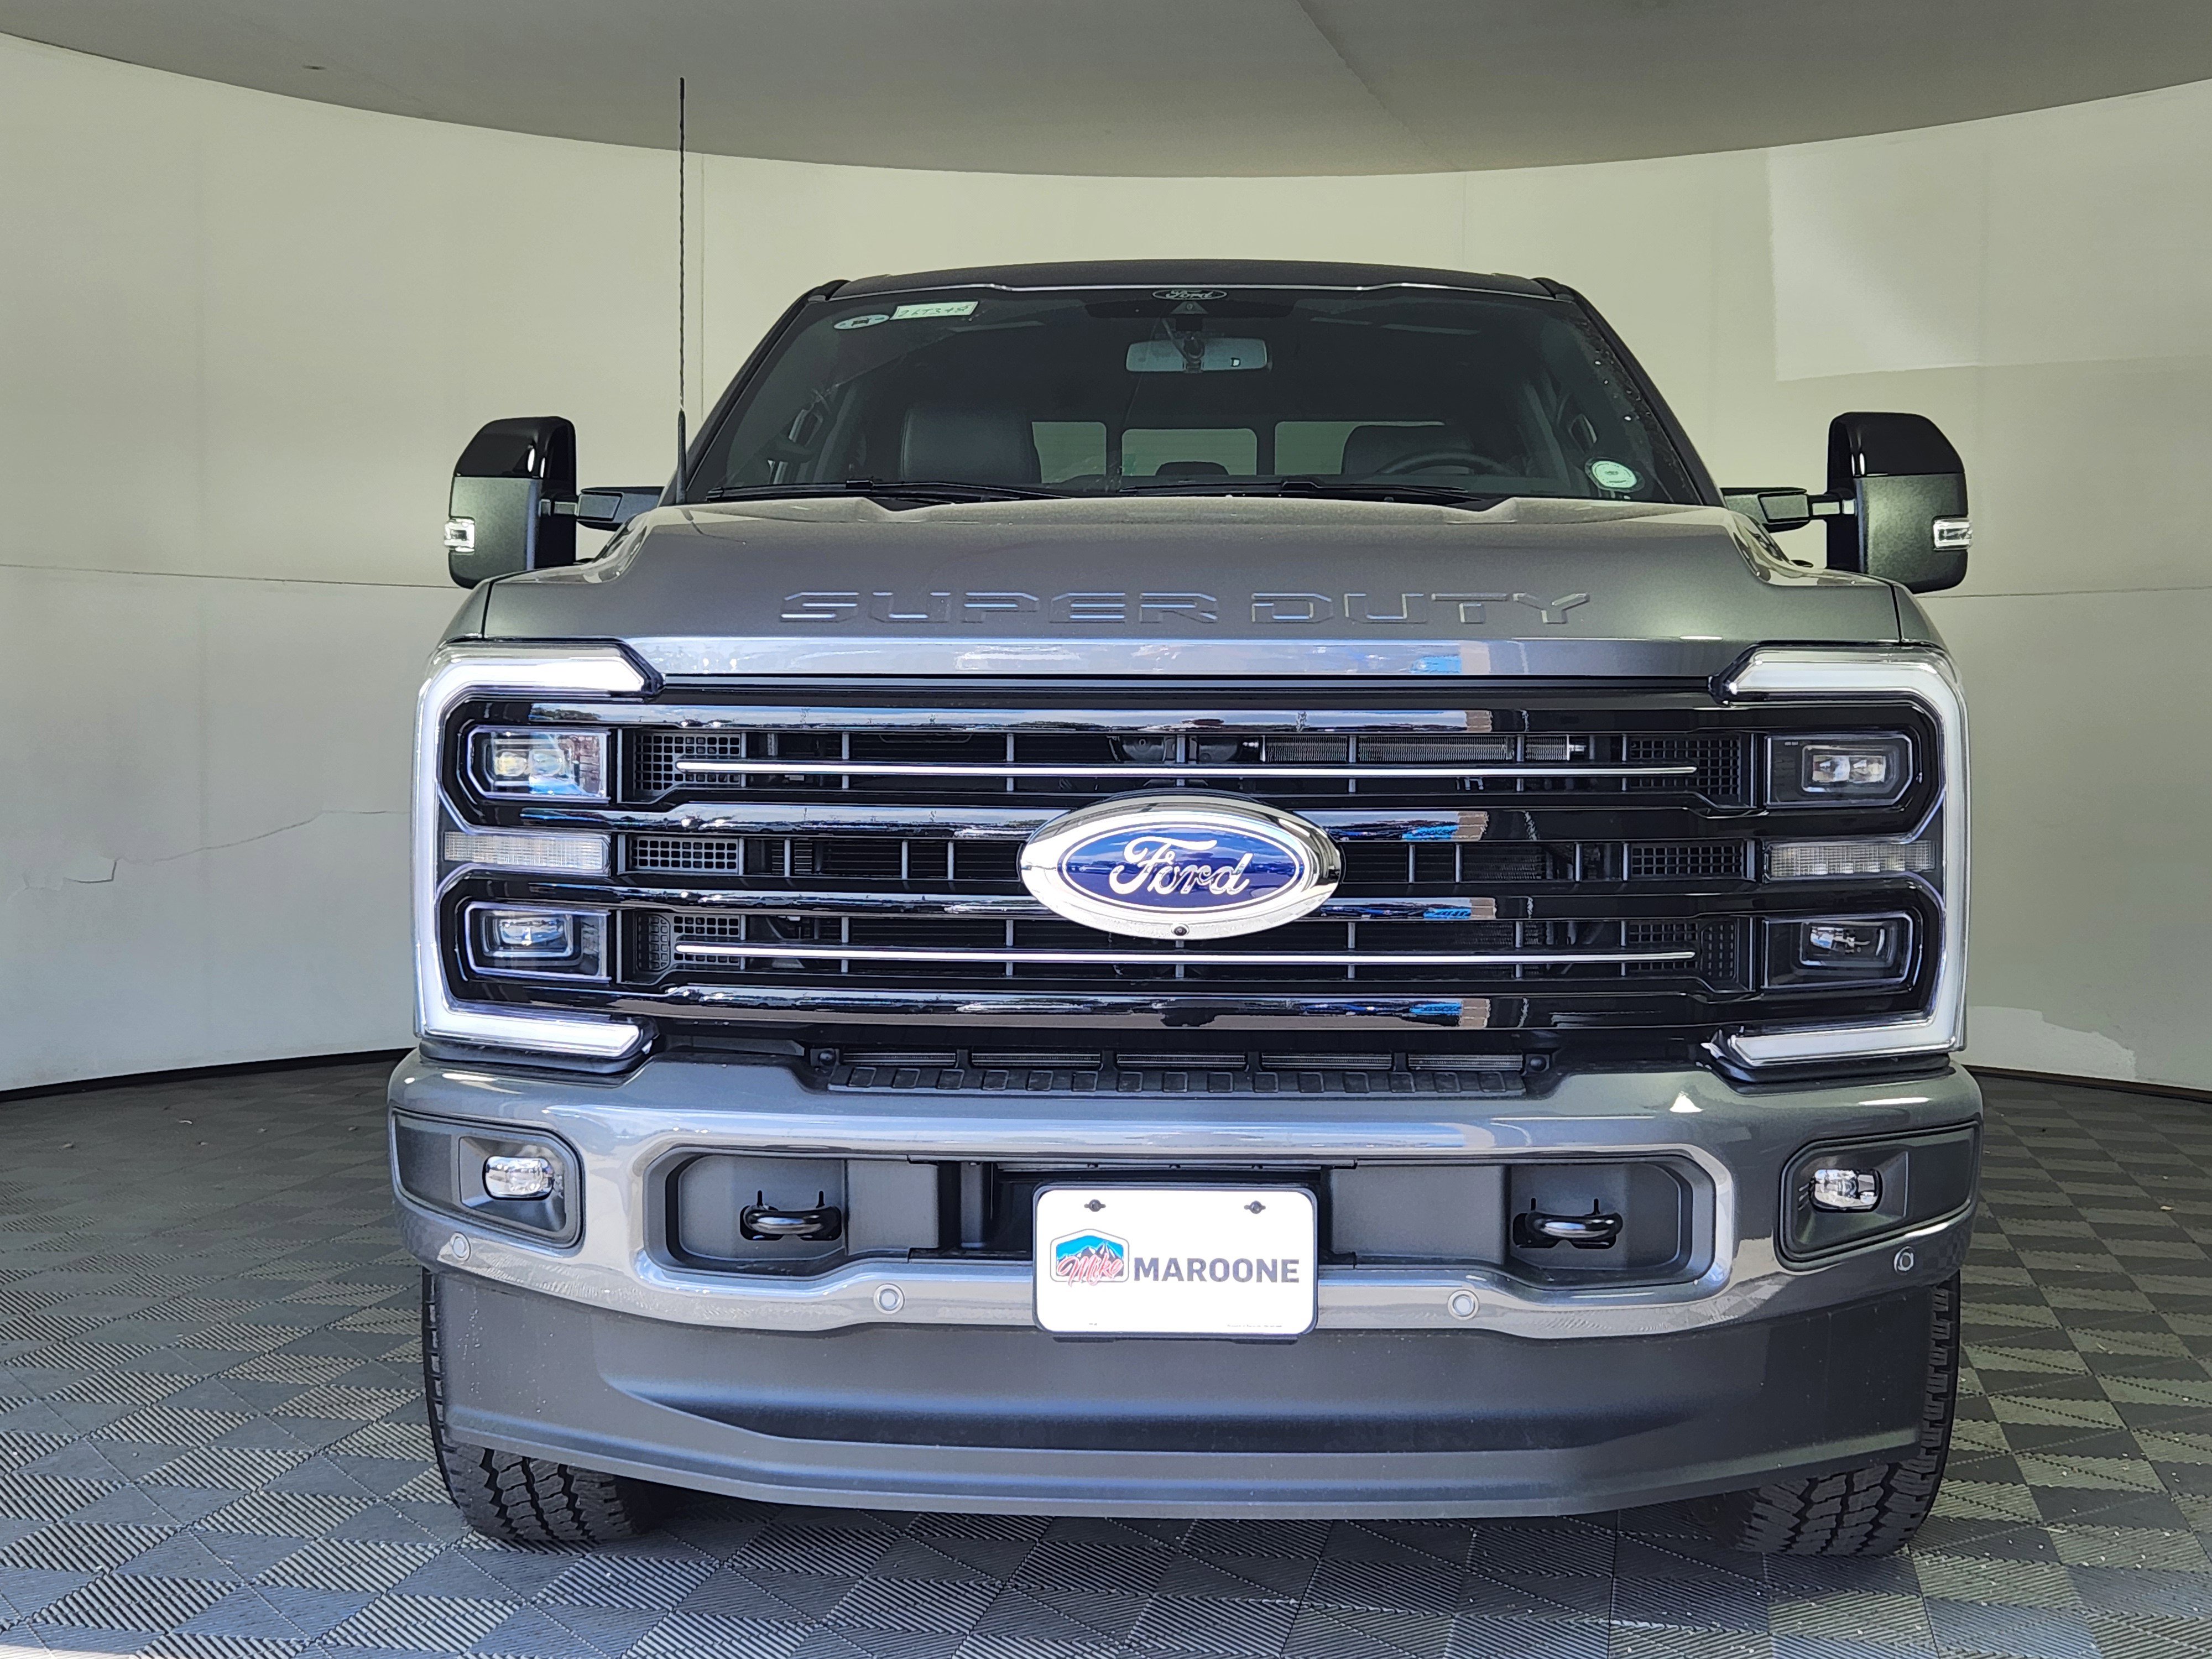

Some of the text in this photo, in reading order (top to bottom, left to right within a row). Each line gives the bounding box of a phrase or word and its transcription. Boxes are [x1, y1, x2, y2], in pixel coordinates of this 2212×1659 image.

[1165, 289, 1213, 299] Ford
[780, 591, 1590, 624] SUPER DUTY
[1108, 836, 1254, 895] Ford
[1056, 1253, 1300, 1287] Mike MAROONE
